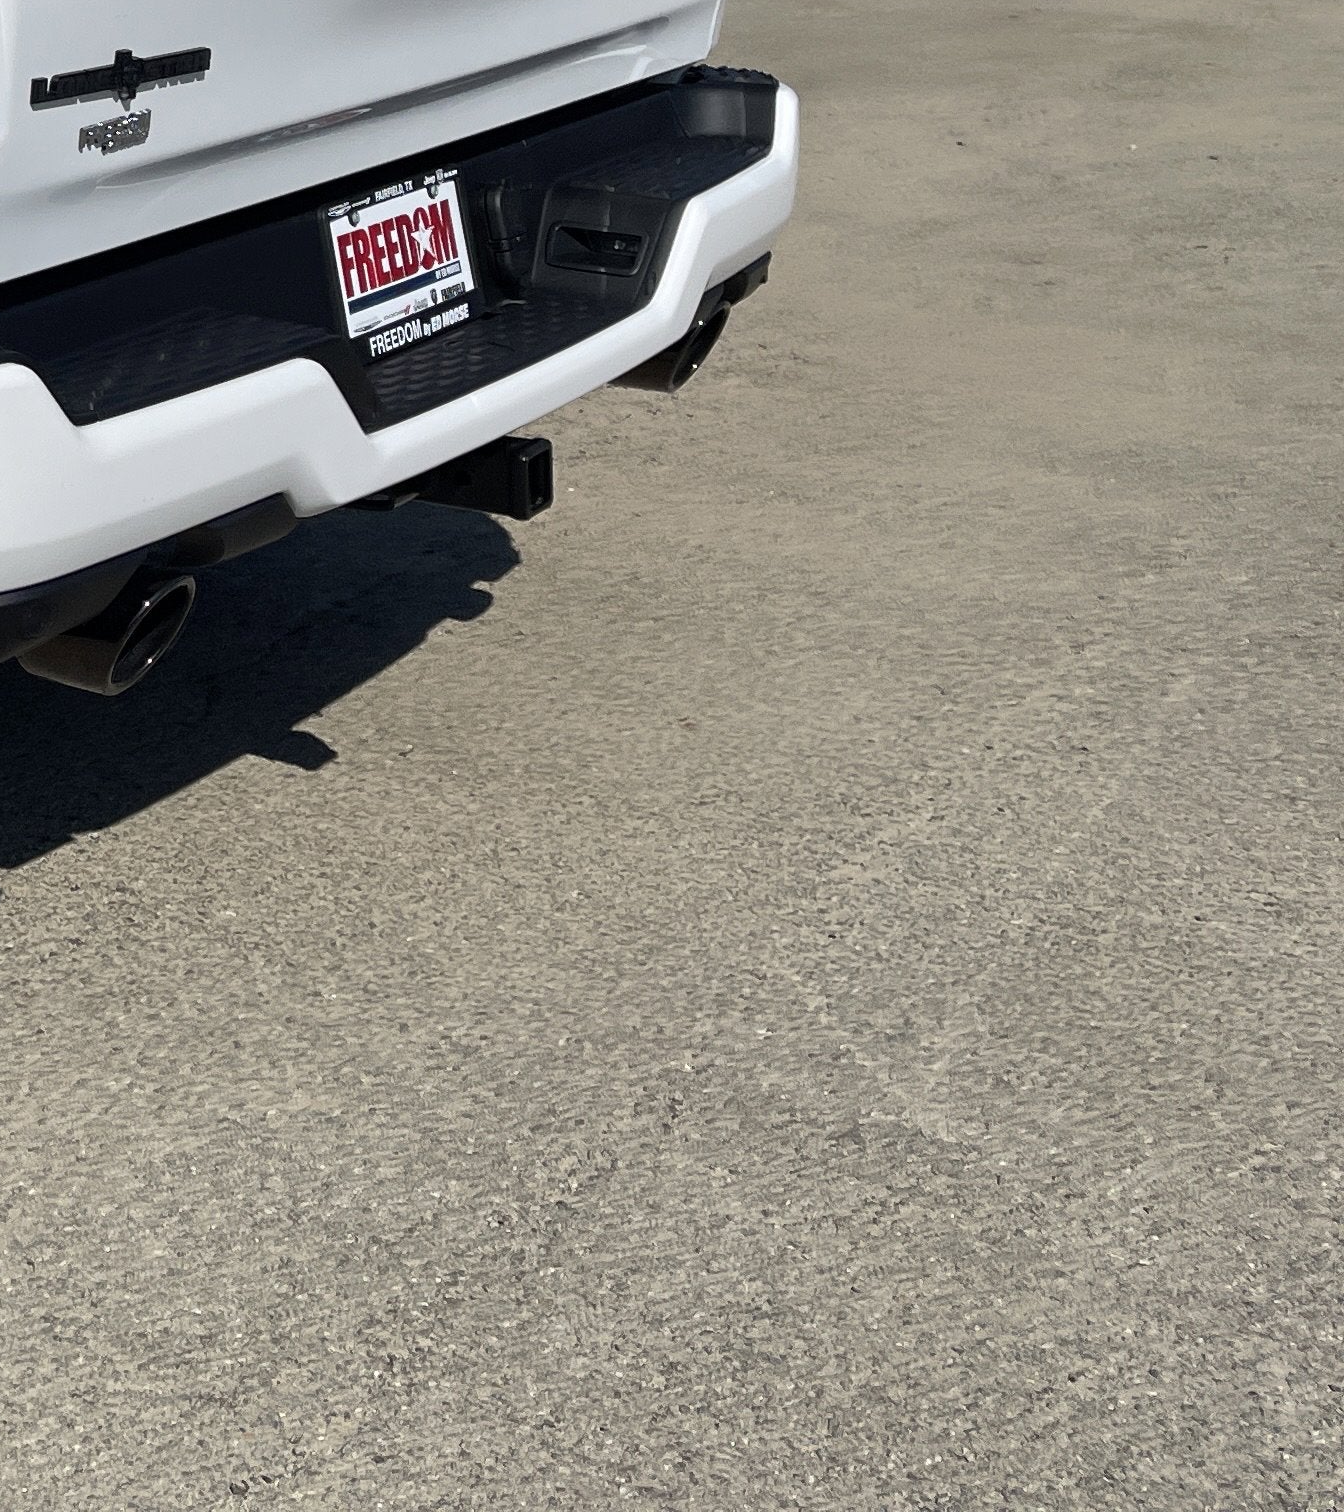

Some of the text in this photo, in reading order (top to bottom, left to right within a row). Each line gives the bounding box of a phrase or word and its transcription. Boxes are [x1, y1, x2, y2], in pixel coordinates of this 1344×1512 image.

[337, 199, 458, 299] FREEDOM
[370, 319, 423, 357] FREEDOM
[431, 315, 442, 332] ED
[442, 303, 470, 328] MORSE
